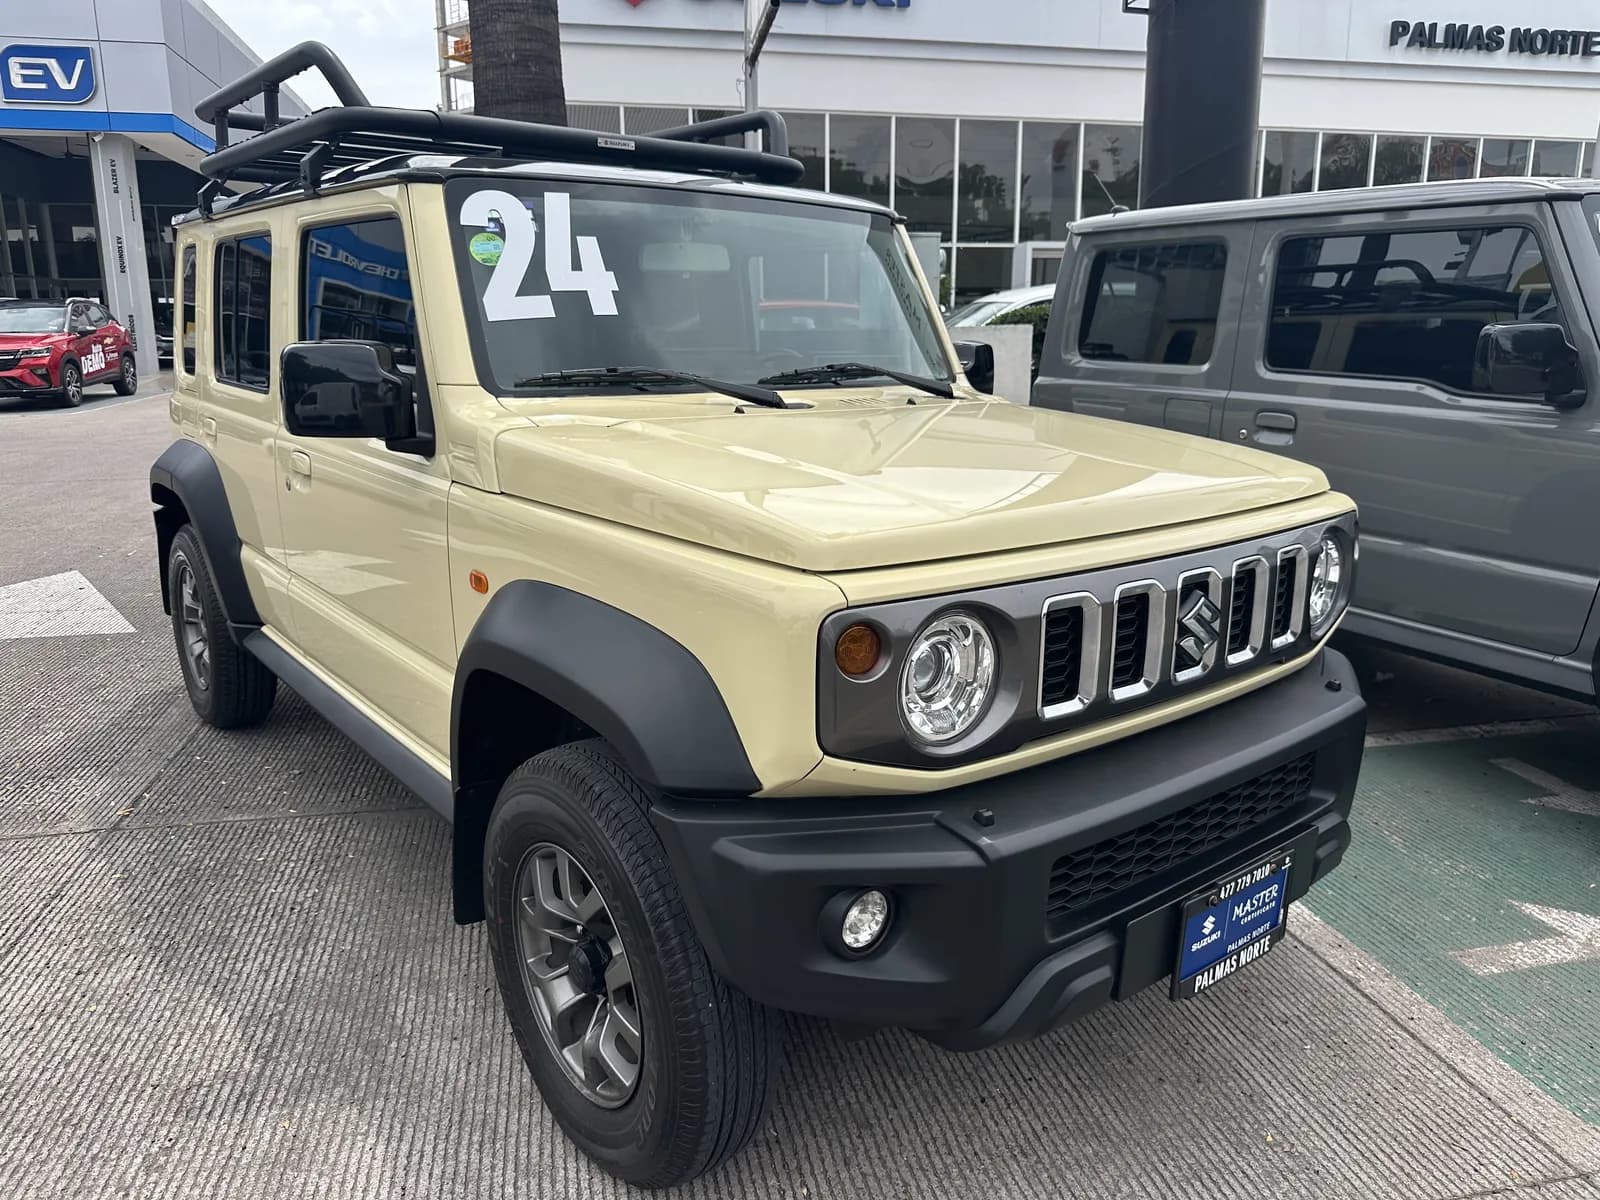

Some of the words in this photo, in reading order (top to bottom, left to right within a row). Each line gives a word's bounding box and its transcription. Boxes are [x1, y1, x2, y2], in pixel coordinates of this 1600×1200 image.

[1389, 20, 1505, 52] PALMAS
[1508, 27, 1600, 57] NORTE
[8, 56, 85, 90] EV
[109, 158, 117, 168] EV
[111, 168, 119, 194] BLAZER
[115, 235, 123, 245] EV
[460, 190, 620, 322] 24
[117, 245, 126, 274] EQUINOX
[81, 352, 106, 374] DEMO
[1219, 883, 1234, 900] 477
[1236, 874, 1251, 892] 779
[1252, 863, 1271, 881] 7010
[1232, 884, 1279, 921] MASTER
[1191, 930, 1221, 952] SUZUKI
[1227, 933, 1251, 954] PALMAS
[1251, 921, 1271, 939] NORTE
[1194, 955, 1238, 993] PALMAS
[1239, 935, 1271, 968] NORTE
